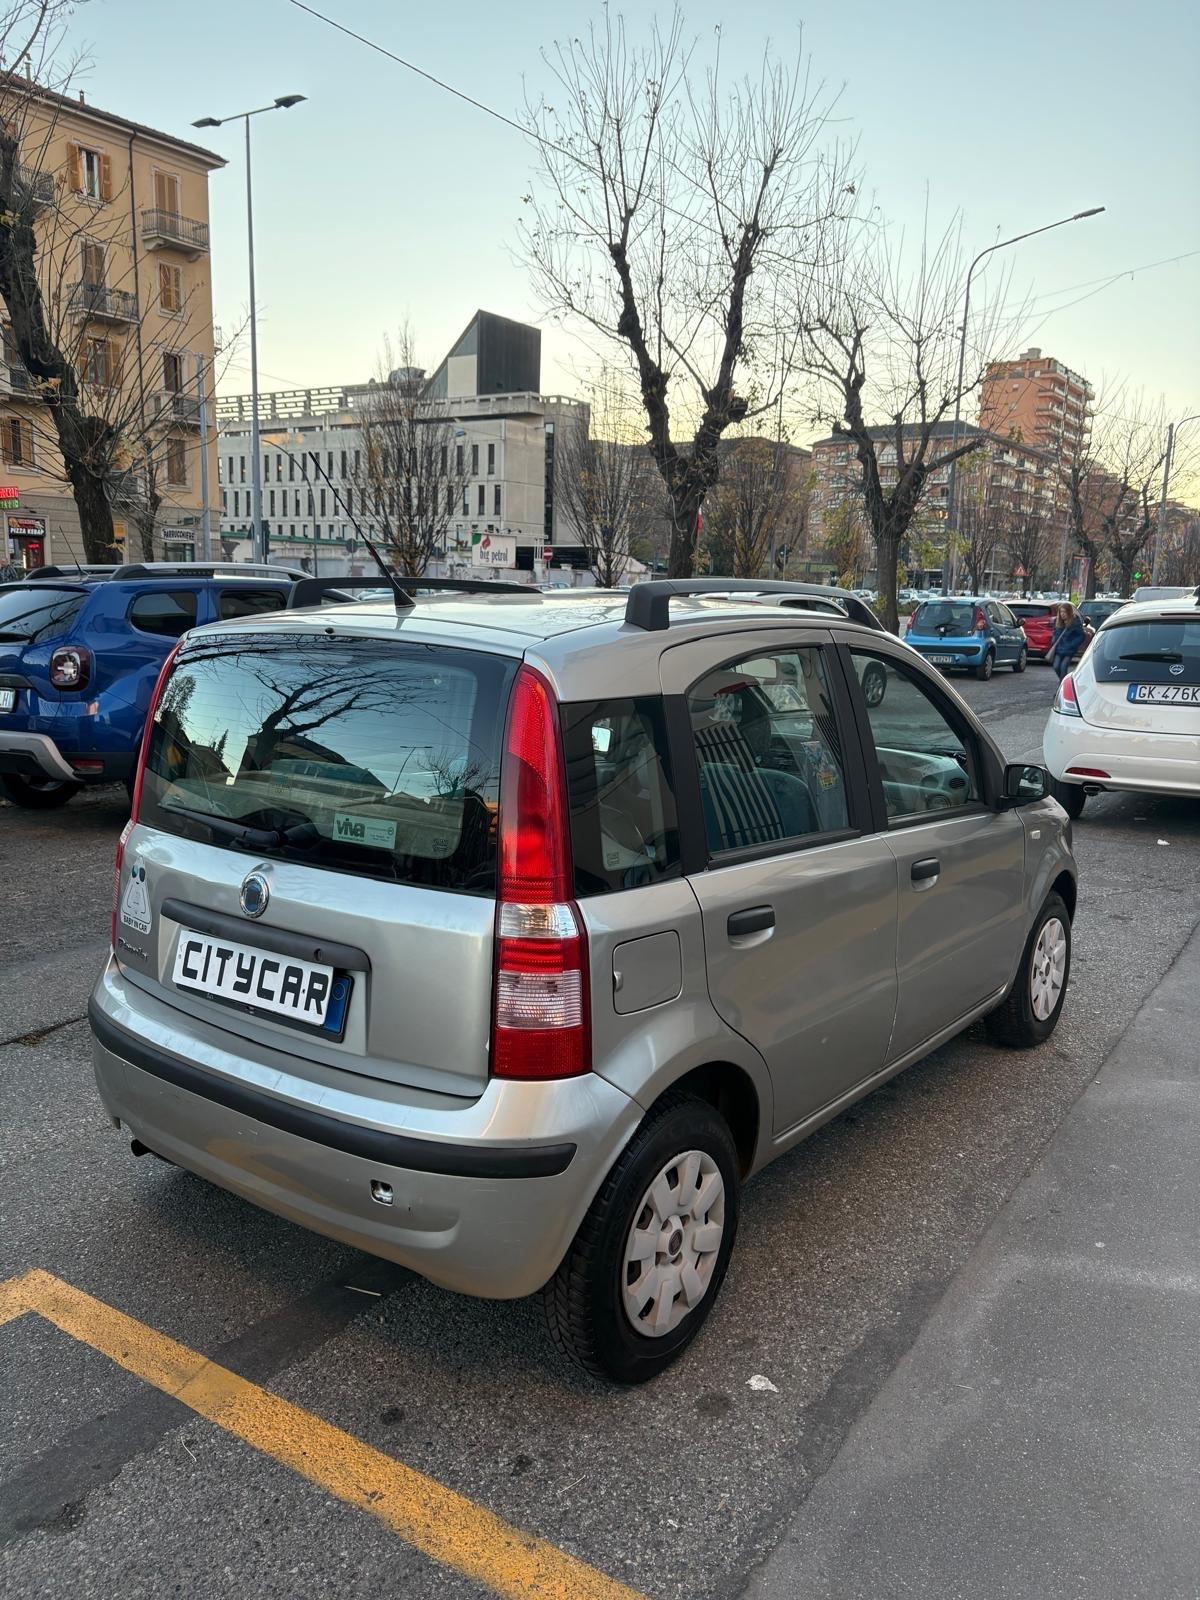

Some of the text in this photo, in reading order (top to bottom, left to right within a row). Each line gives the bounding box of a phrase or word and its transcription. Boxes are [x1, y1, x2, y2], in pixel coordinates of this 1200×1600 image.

[480, 546, 508, 563] big petrol
[123, 915, 148, 933] BABY IN CAR
[182, 940, 329, 1015] CITYCAR
